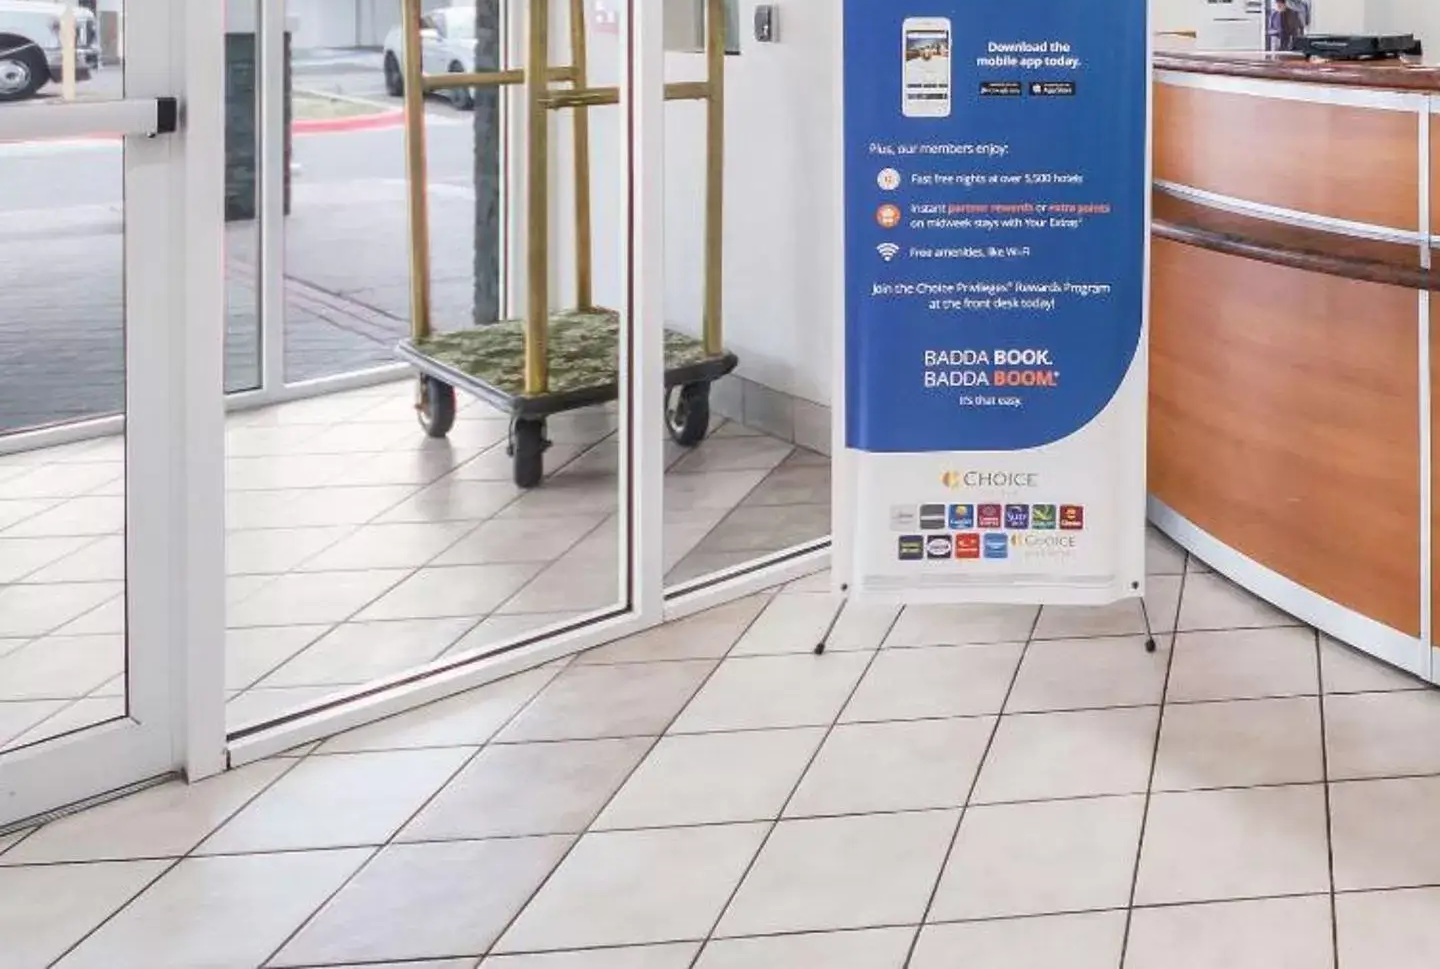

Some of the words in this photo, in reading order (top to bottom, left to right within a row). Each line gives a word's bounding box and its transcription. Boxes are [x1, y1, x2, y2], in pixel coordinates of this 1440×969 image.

[988, 41, 1047, 52] Download
[1050, 41, 1071, 52] the
[976, 55, 1017, 66] mobile
[1019, 57, 1042, 69] app
[1044, 55, 1082, 69] today.
[869, 142, 895, 155] Plus,
[898, 145, 916, 154] our
[920, 142, 974, 154] members
[976, 143, 1009, 157] enjoy:
[911, 173, 932, 183] Fast
[934, 173, 954, 183] free
[956, 173, 986, 186] nights
[1000, 175, 1022, 183] over
[910, 204, 946, 213] Instant
[1035, 205, 1047, 213] or
[910, 219, 924, 228] on
[926, 217, 972, 228] midweek
[974, 219, 1000, 231] stays
[1000, 217, 1023, 228] with
[1024, 218, 1047, 228] Your
[910, 247, 932, 258] Free
[872, 283, 892, 296] Join
[895, 282, 913, 294] the
[915, 282, 954, 295] Choice
[1063, 283, 1110, 296] Program
[928, 299, 941, 309] at
[943, 298, 961, 309] the
[963, 298, 990, 309] front
[994, 298, 1018, 309] desk
[1020, 298, 1055, 311] today!
[924, 350, 989, 366] BADDA
[994, 349, 1053, 366] BOOK.
[924, 371, 989, 387] BADDA
[975, 395, 997, 406] that
[963, 471, 1038, 487] CHOICE
